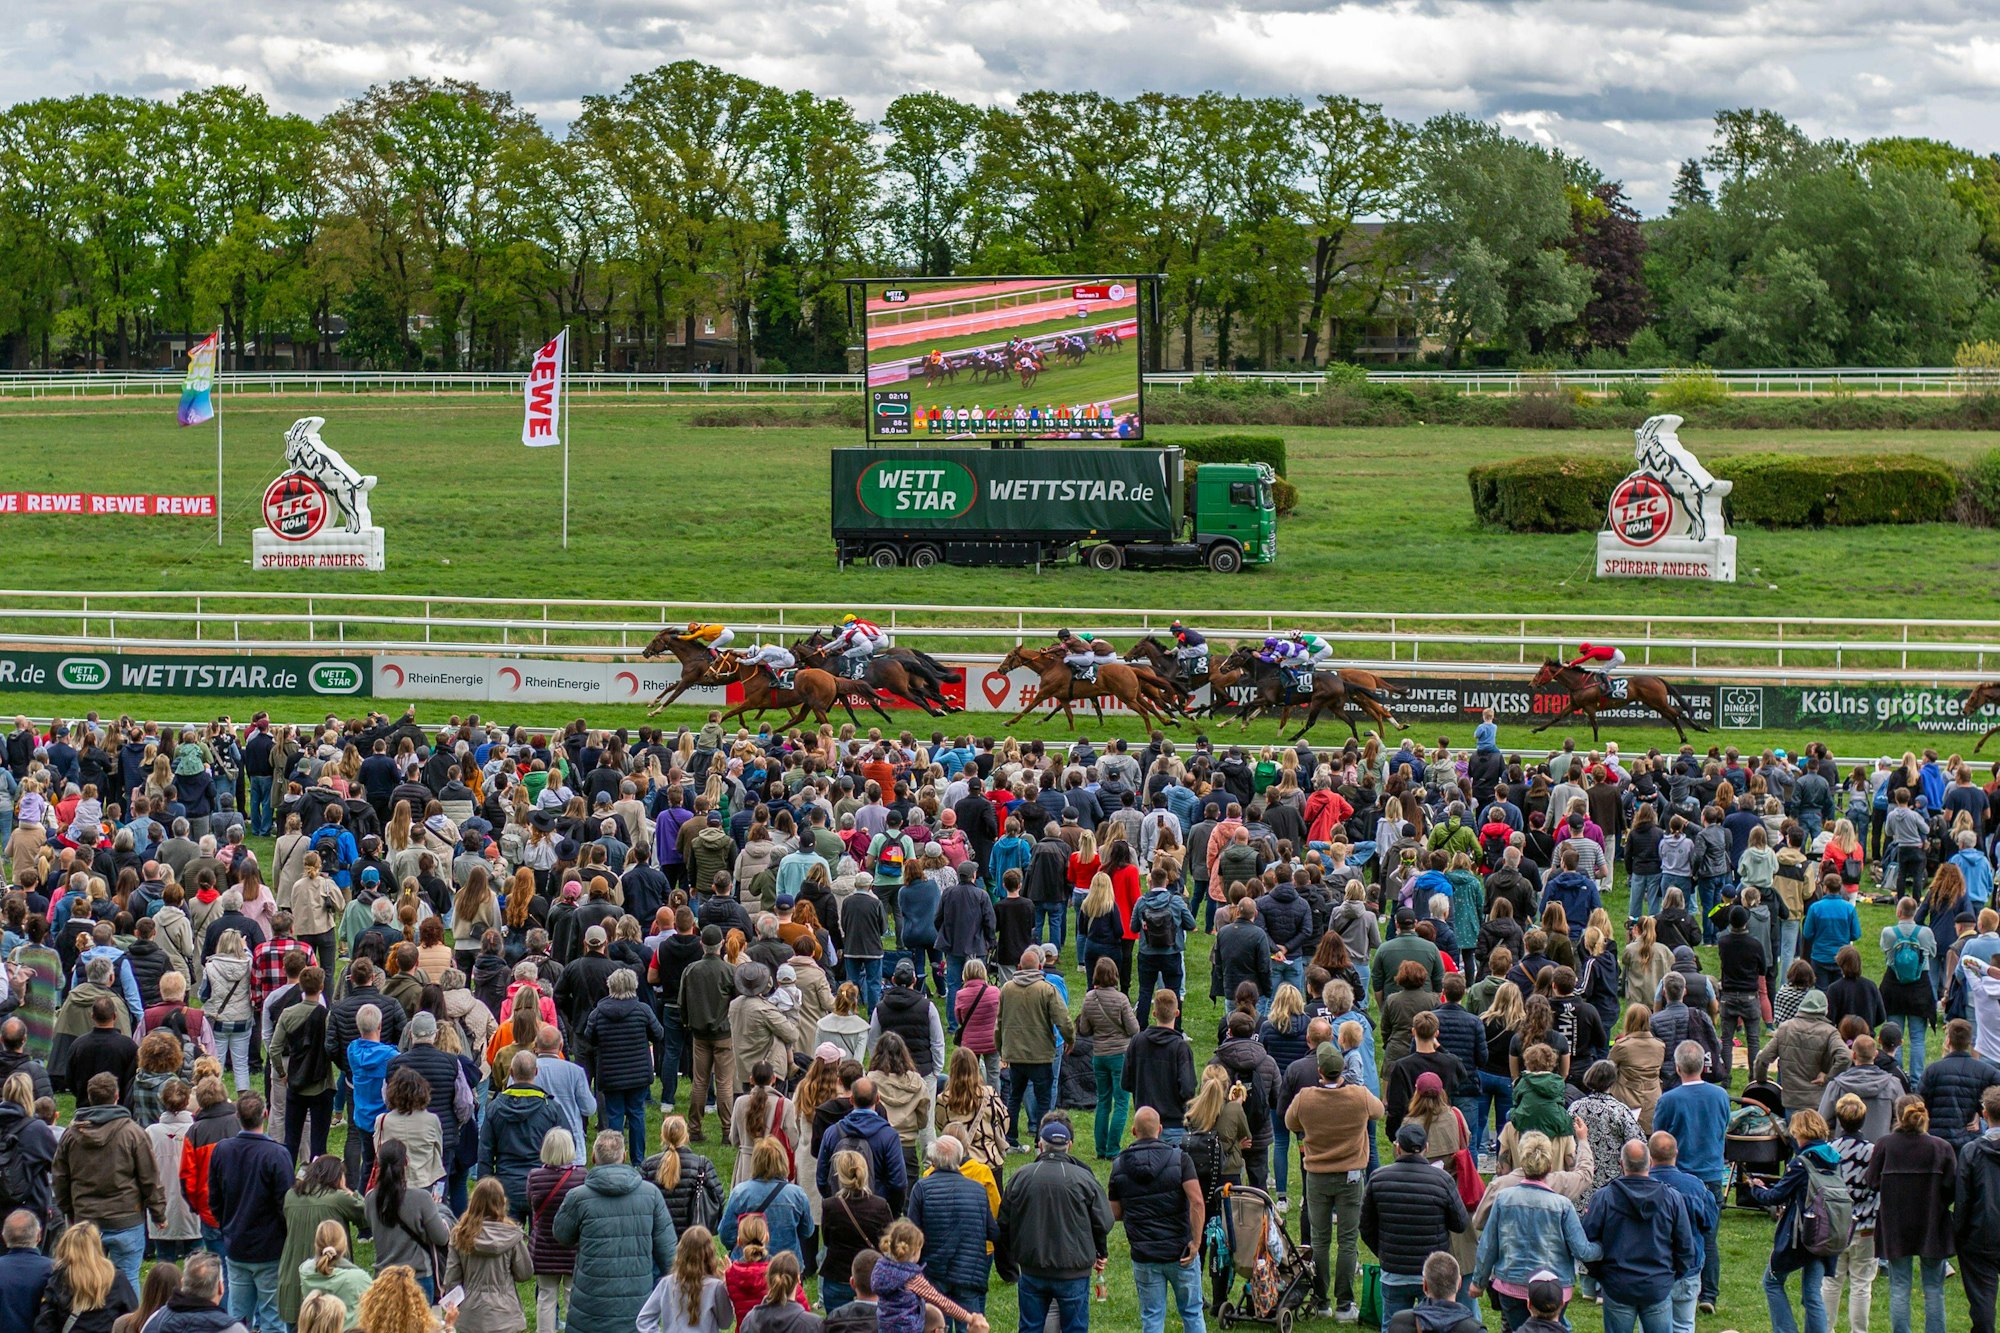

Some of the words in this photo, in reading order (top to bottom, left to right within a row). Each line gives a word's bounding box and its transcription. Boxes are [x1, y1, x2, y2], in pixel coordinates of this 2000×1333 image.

[529, 340, 557, 438] REWE
[879, 470, 945, 488] WETT
[990, 480, 1153, 501] WETTSTAR.de
[27, 495, 81, 511] REWE
[92, 496, 146, 513] REWE
[156, 497, 212, 514] REWE
[896, 491, 956, 511] STAR
[281, 513, 308, 531] KÖLN
[1625, 517, 1652, 536] KÖLN
[262, 552, 316, 567] SPÜRBAR
[319, 554, 368, 567] ANDERS.
[1605, 558, 1658, 575] SPÜRBAR
[1662, 562, 1711, 577] ANDERS.
[69, 666, 95, 674] WETT
[76, 674, 99, 682] STAR
[122, 664, 297, 689] WETTSTAR.de
[320, 670, 347, 678] WETT
[327, 678, 351, 686] STAR
[408, 672, 484, 686] RheinEnergie
[525, 676, 600, 691] RheinEnergie
[1297, 673, 1313, 686] 10
[1613, 679, 1628, 691] 12
[1463, 691, 1530, 714] LANXESS
[1802, 691, 1869, 714] Kölns
